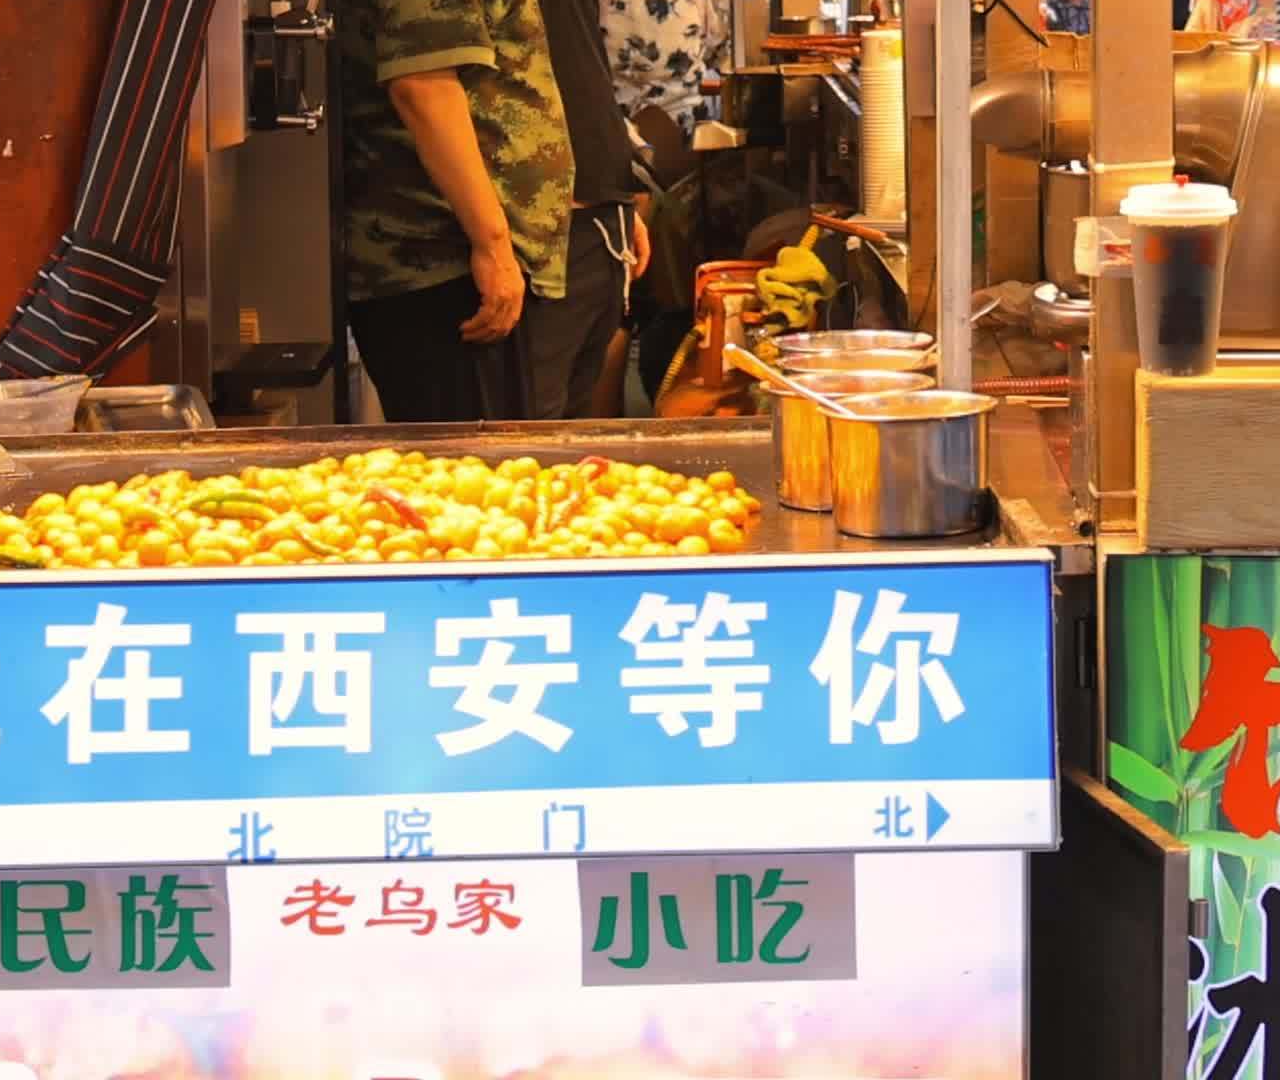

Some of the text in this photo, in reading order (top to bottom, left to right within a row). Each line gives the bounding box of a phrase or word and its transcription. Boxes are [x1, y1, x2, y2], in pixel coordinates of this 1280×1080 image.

[873, 796, 914, 839] 北
[0, 874, 216, 973] 民族
[280, 878, 523, 936] 老乌家
[592, 867, 811, 969] 小吃
